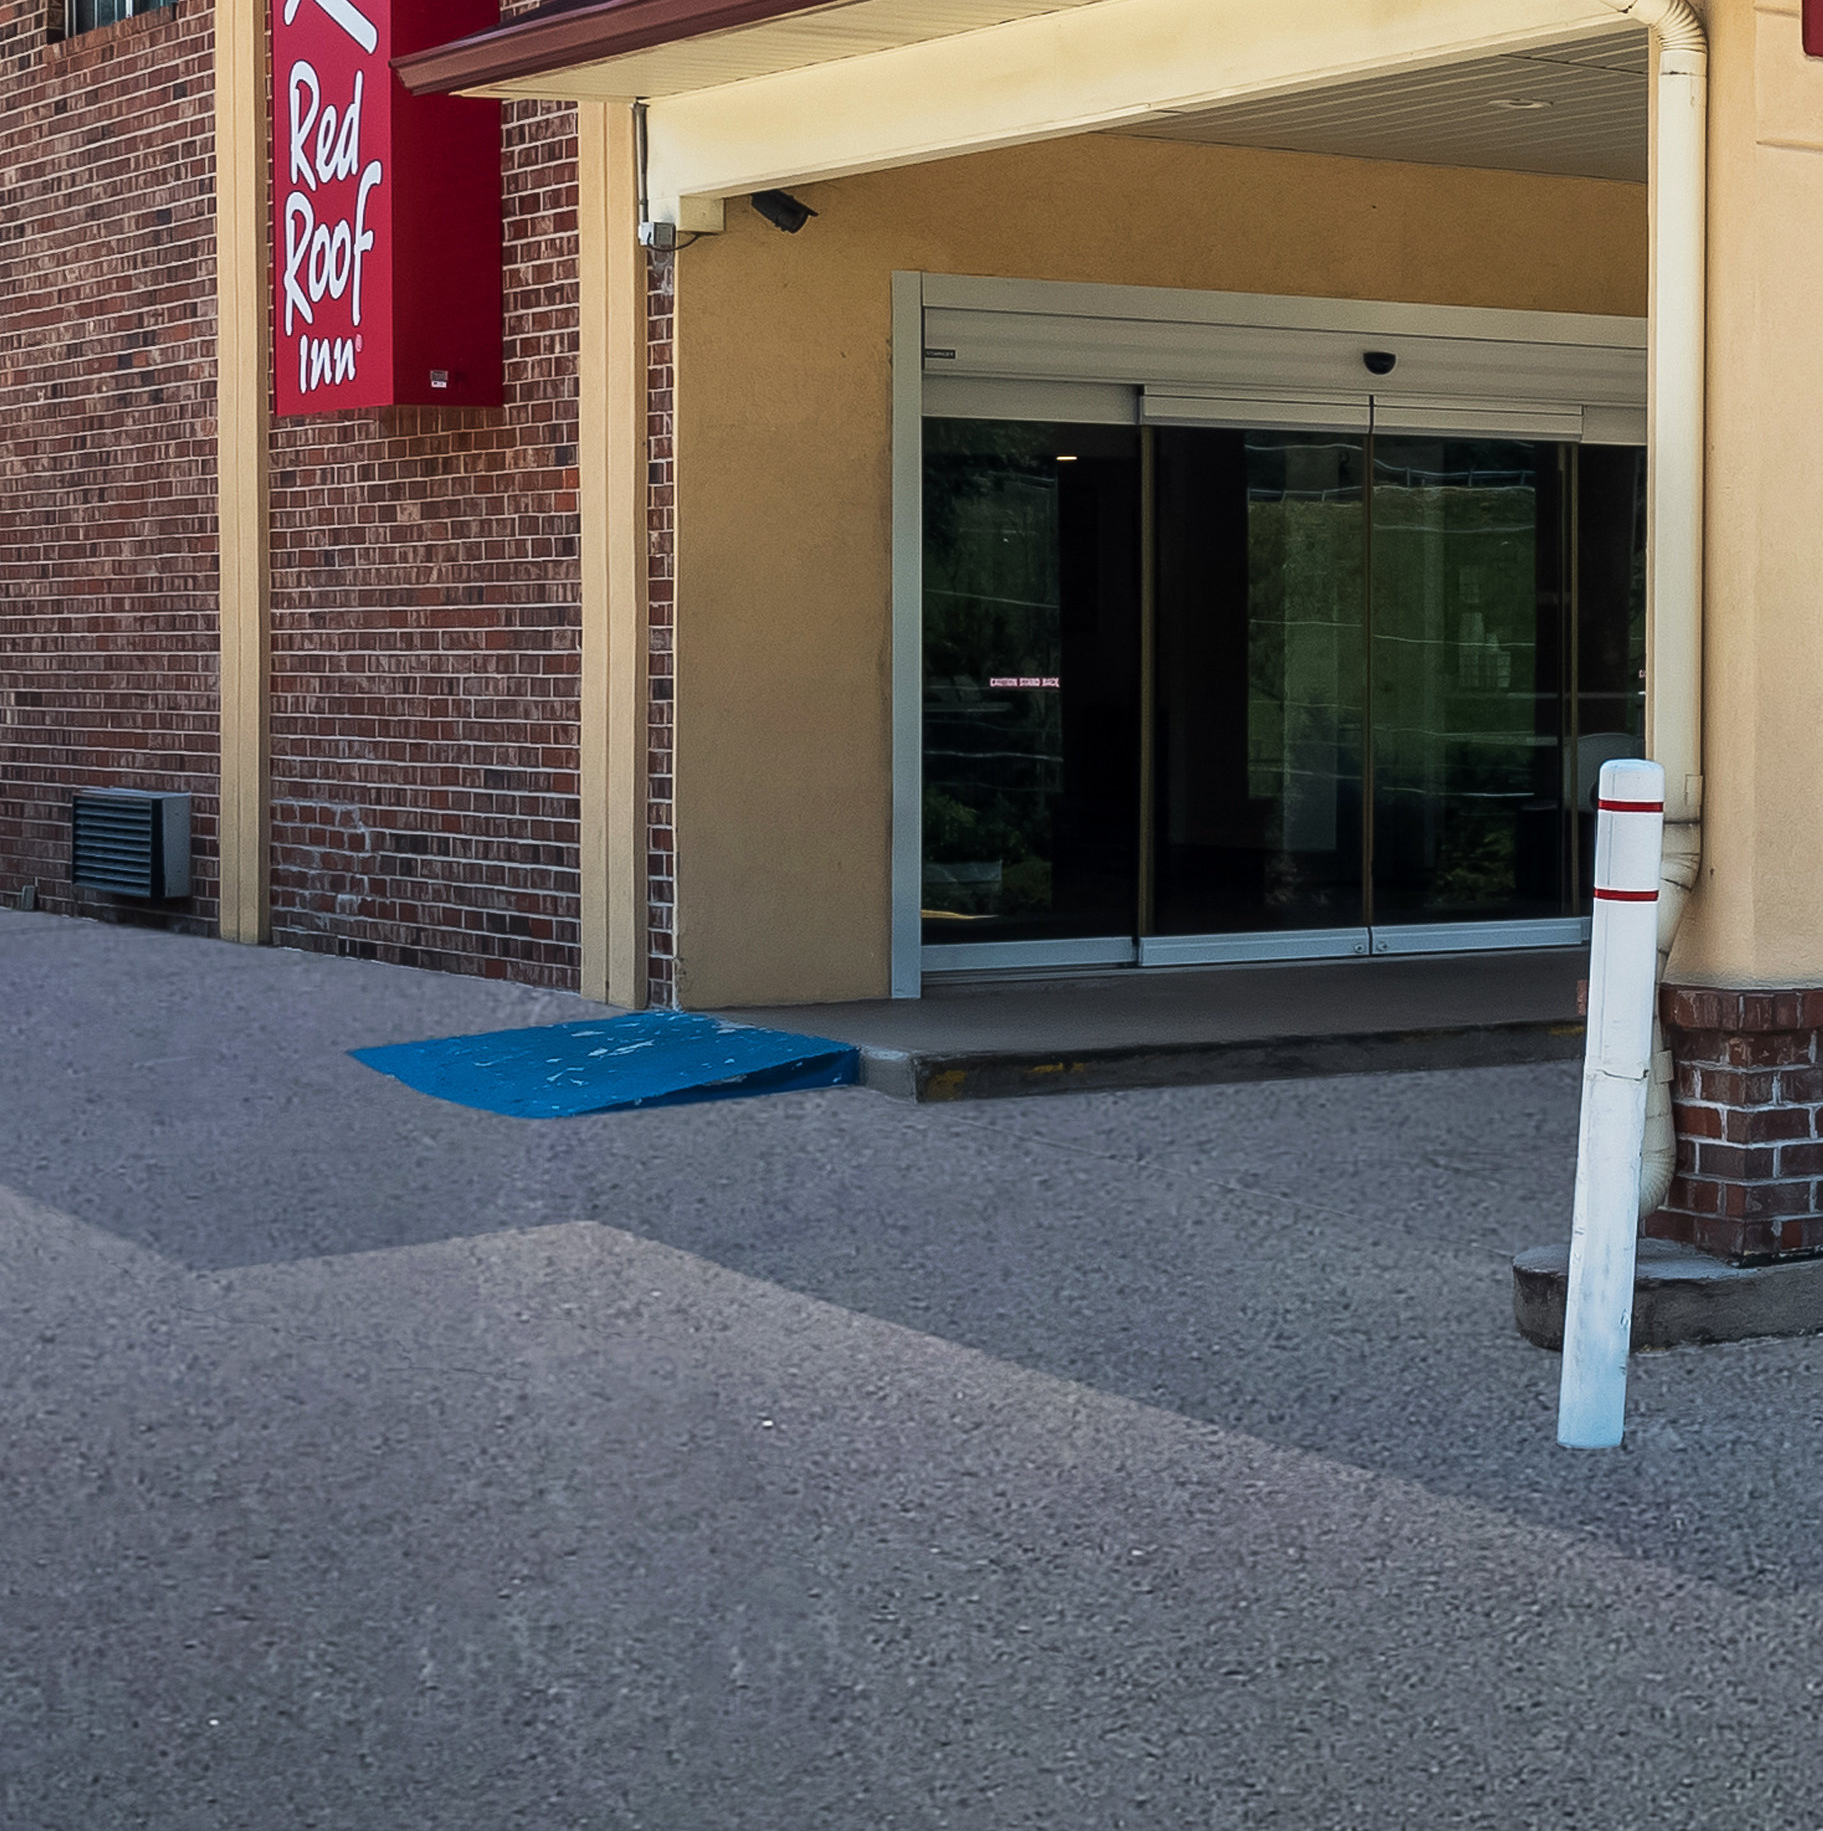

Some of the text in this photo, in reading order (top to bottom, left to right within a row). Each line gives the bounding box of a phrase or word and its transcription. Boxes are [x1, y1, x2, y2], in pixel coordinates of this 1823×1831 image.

[288, 59, 363, 192] Red
[282, 159, 382, 337] Roof
[299, 333, 356, 394] Inn
